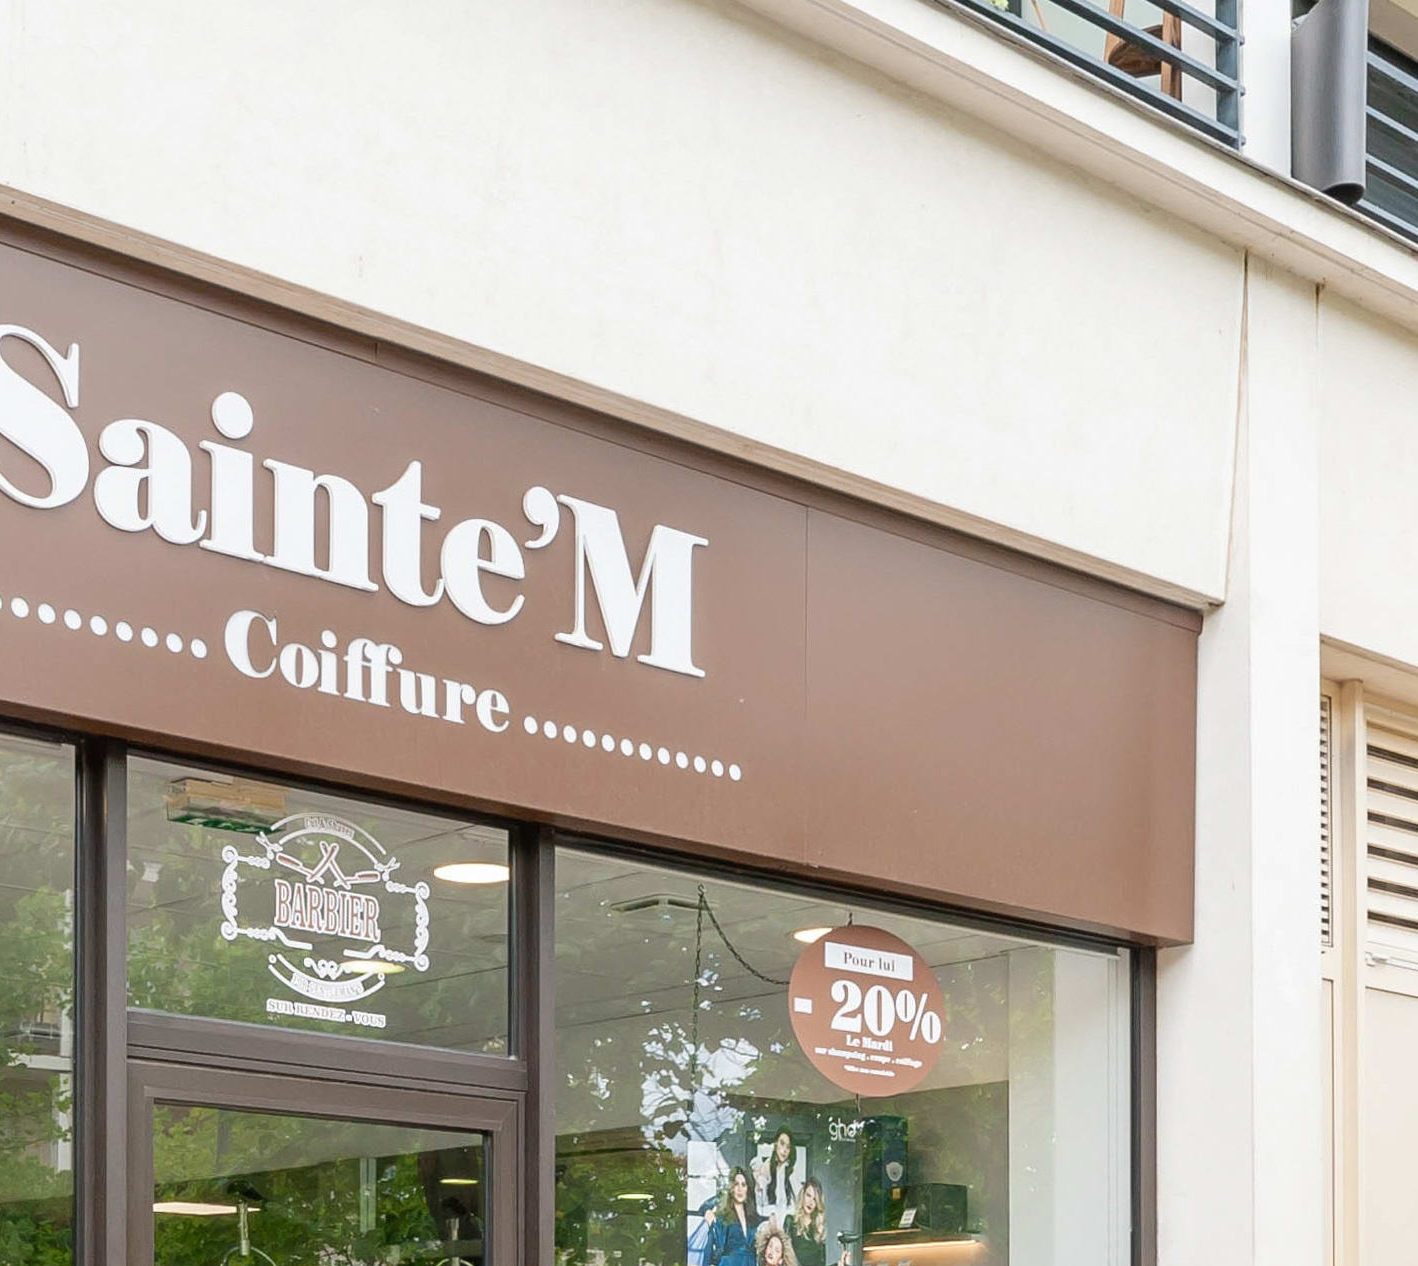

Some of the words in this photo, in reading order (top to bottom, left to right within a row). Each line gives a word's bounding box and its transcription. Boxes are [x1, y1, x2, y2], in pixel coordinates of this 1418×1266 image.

[224, 608, 509, 732] Coiffure
[274, 878, 381, 942] BARBIER
[844, 951, 875, 969] Pour
[878, 957, 895, 973] lui
[266, 998, 295, 1014] SUR
[846, 1034, 861, 1047] Le
[862, 1036, 893, 1052] Mardi
